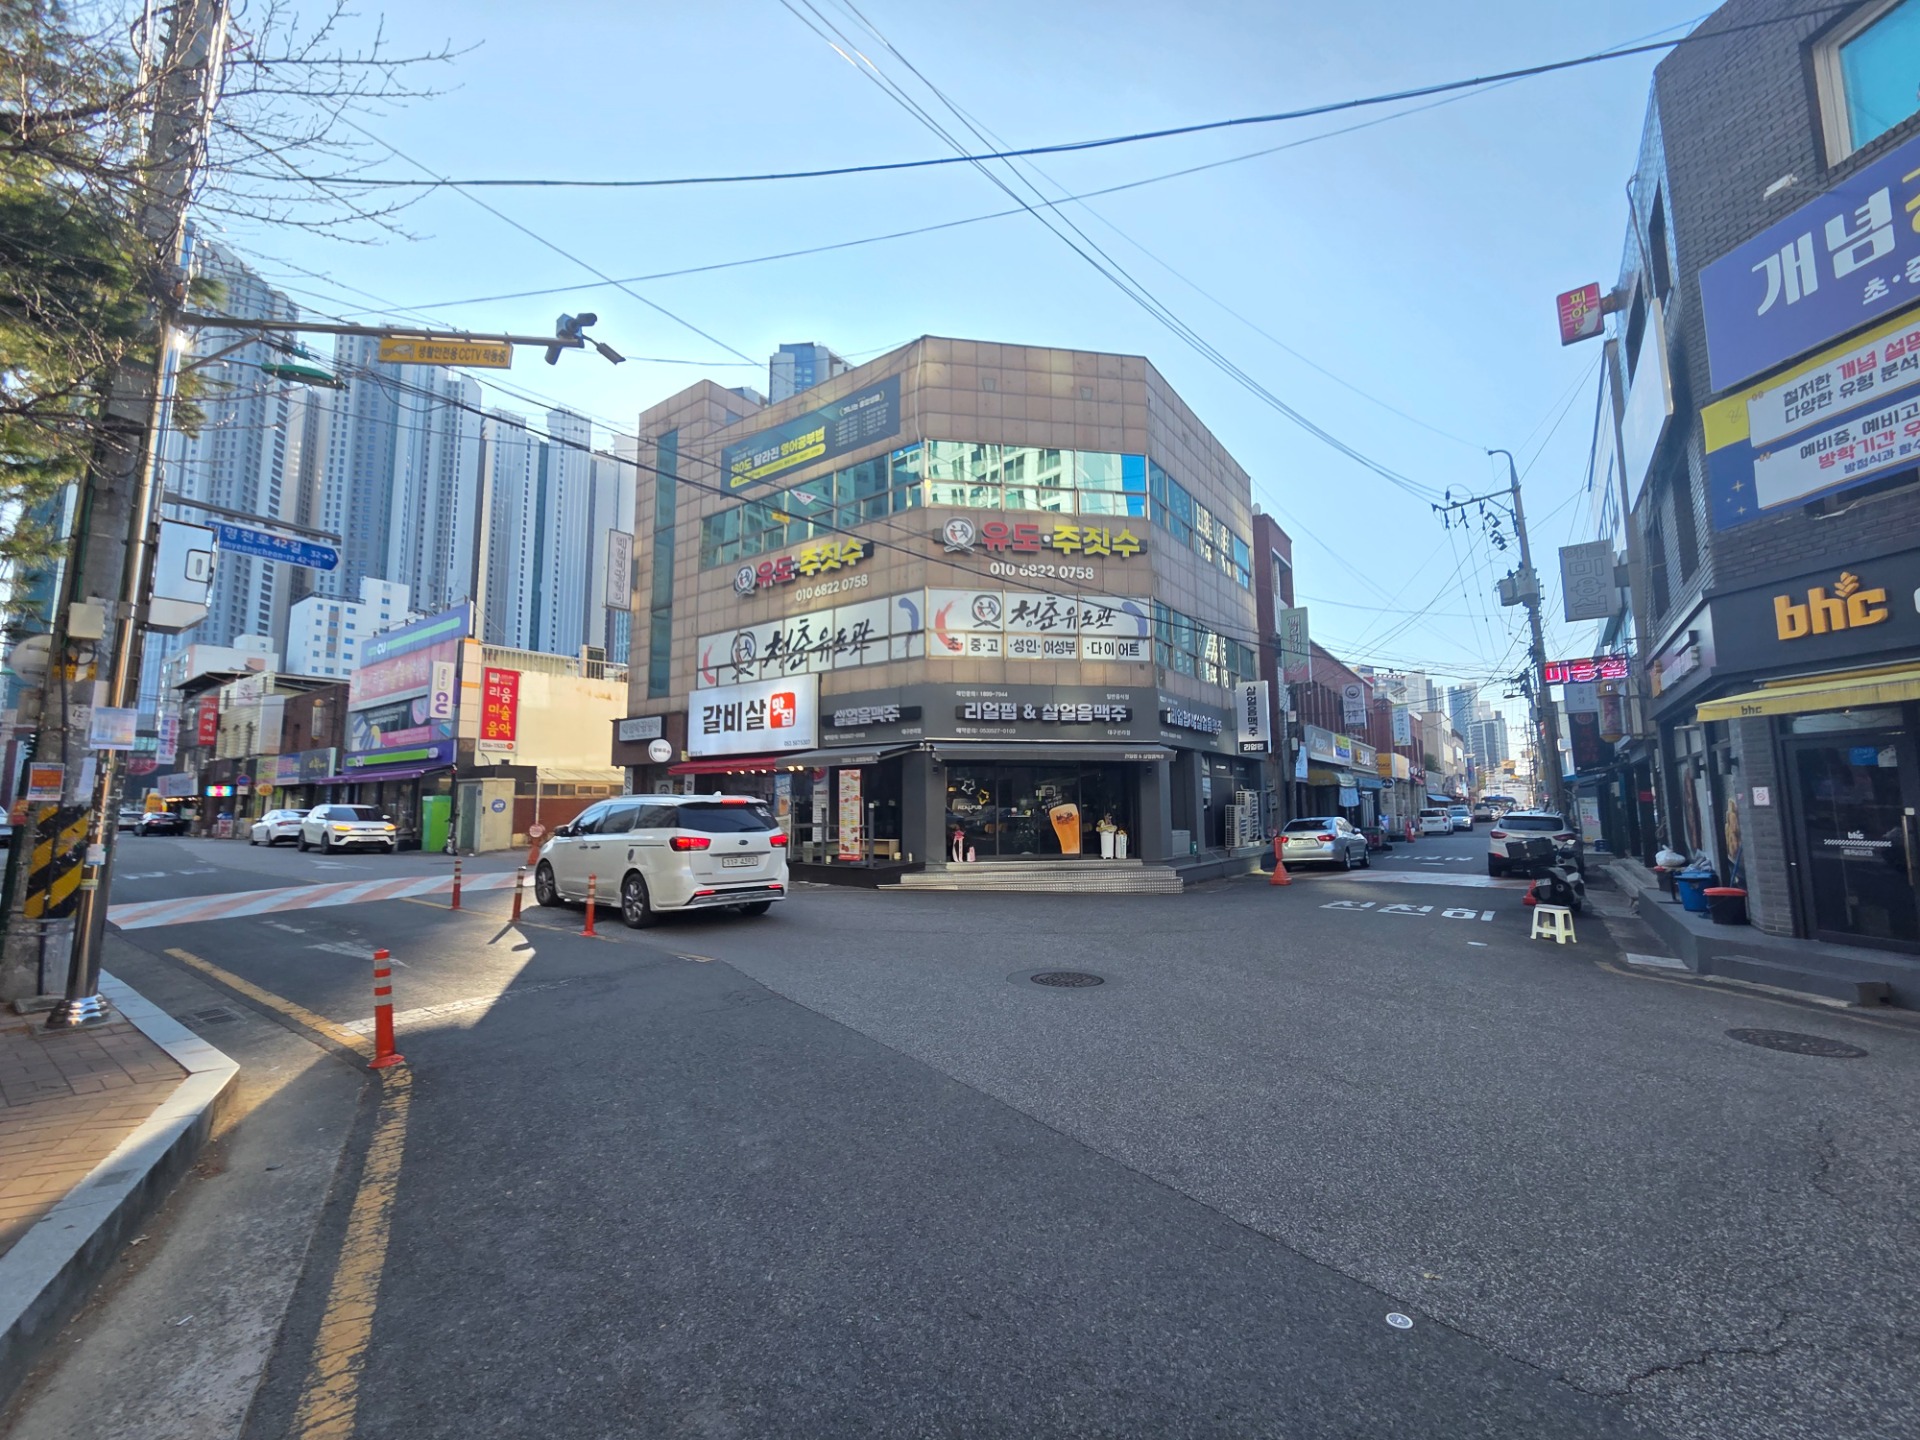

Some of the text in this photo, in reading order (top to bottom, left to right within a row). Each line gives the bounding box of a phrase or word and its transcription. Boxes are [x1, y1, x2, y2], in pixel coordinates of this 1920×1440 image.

[1783, 372, 1831, 407] 철저한
[1836, 351, 1877, 380] 개념
[1785, 354, 1920, 424] 다양한 유형 분석
[754, 446, 780, 468] 달라진
[780, 426, 826, 456] 영어공부법
[1818, 429, 1896, 470] 방학기간
[990, 562, 1016, 576] 010
[1059, 566, 1094, 580] 0758
[796, 574, 868, 602] 010 6822 0758
[1774, 582, 1888, 640] bhc
[377, 642, 386, 655] CU
[434, 692, 448, 714] CU
[489, 686, 512, 704] 리움
[488, 703, 512, 720] 미술
[702, 698, 766, 735] 갈비살
[772, 696, 794, 727] 맛집
[834, 704, 900, 727] 살얼음맥주
[964, 702, 1126, 722] 리얼펍 & 살얼음맥주
[1246, 686, 1258, 737] 살얼음맥주
[1741, 705, 1762, 716] bhc
[486, 721, 512, 737] 음악
[1318, 900, 1496, 922] 천천히
